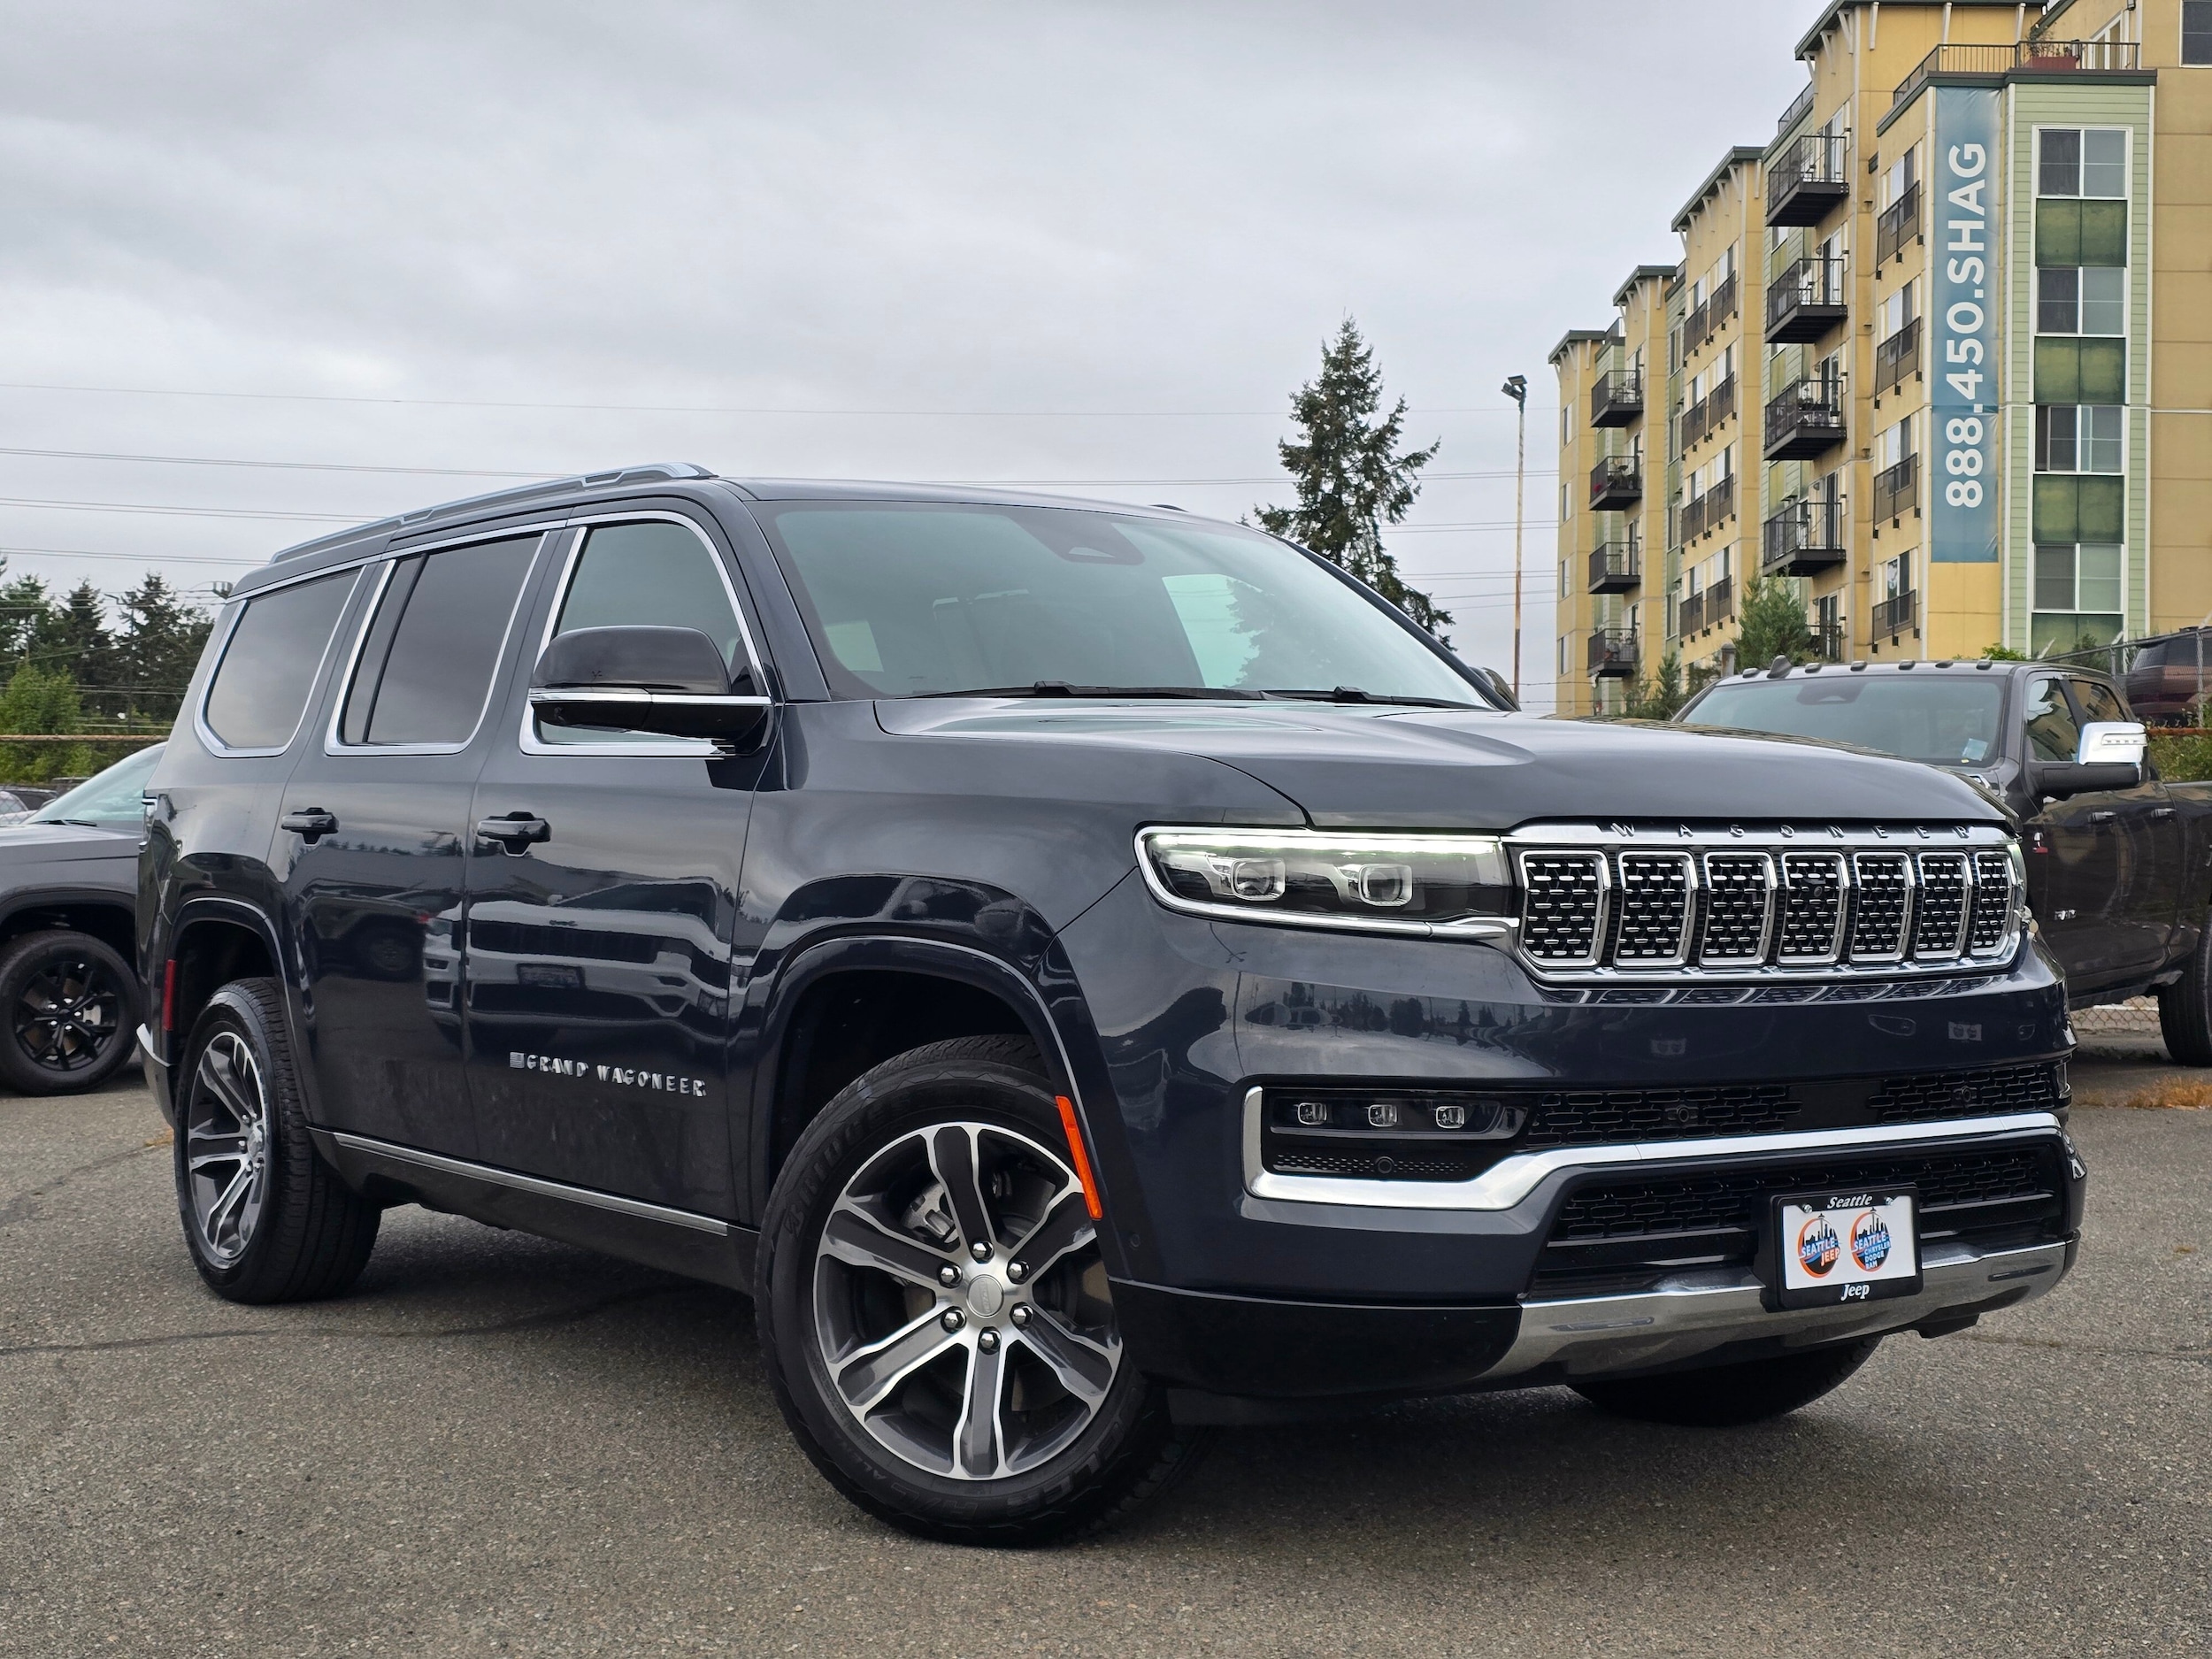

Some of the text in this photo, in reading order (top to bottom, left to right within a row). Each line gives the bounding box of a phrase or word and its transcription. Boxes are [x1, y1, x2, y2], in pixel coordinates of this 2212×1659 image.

[1946, 142, 1986, 508] 888.450.SHAG
[1610, 822, 1970, 838] WAGONEER
[527, 1054, 707, 1097] GRAND WAGONEER
[1827, 1194, 1873, 1210] Seattle
[1821, 1248, 1840, 1266] JEEP
[1864, 1250, 1885, 1263] DODGE
[1840, 1284, 1870, 1301] Jeep
